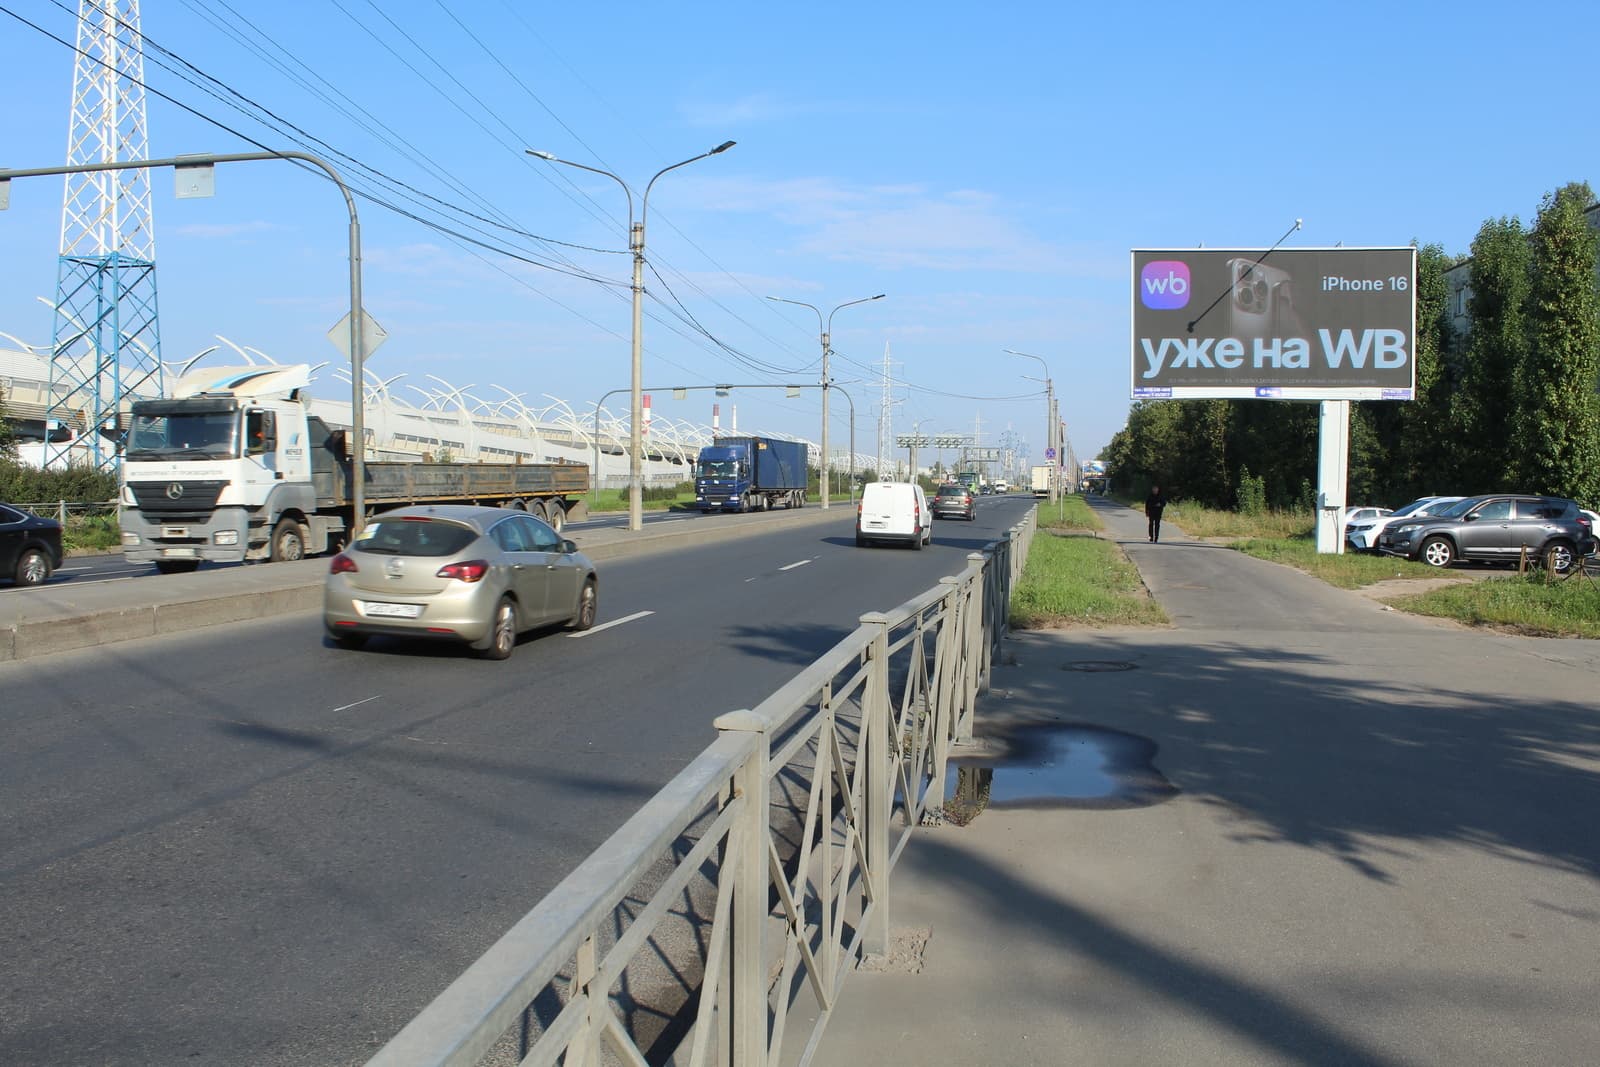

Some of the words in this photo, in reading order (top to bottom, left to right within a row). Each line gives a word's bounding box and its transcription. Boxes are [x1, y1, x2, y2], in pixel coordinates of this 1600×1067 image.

[1144, 271, 1187, 295] wb
[1323, 276, 1384, 291] iPhone
[1388, 276, 1408, 291] 16
[1141, 337, 1244, 379] уже
[1253, 338, 1310, 369] на
[1318, 328, 1407, 369] WB
